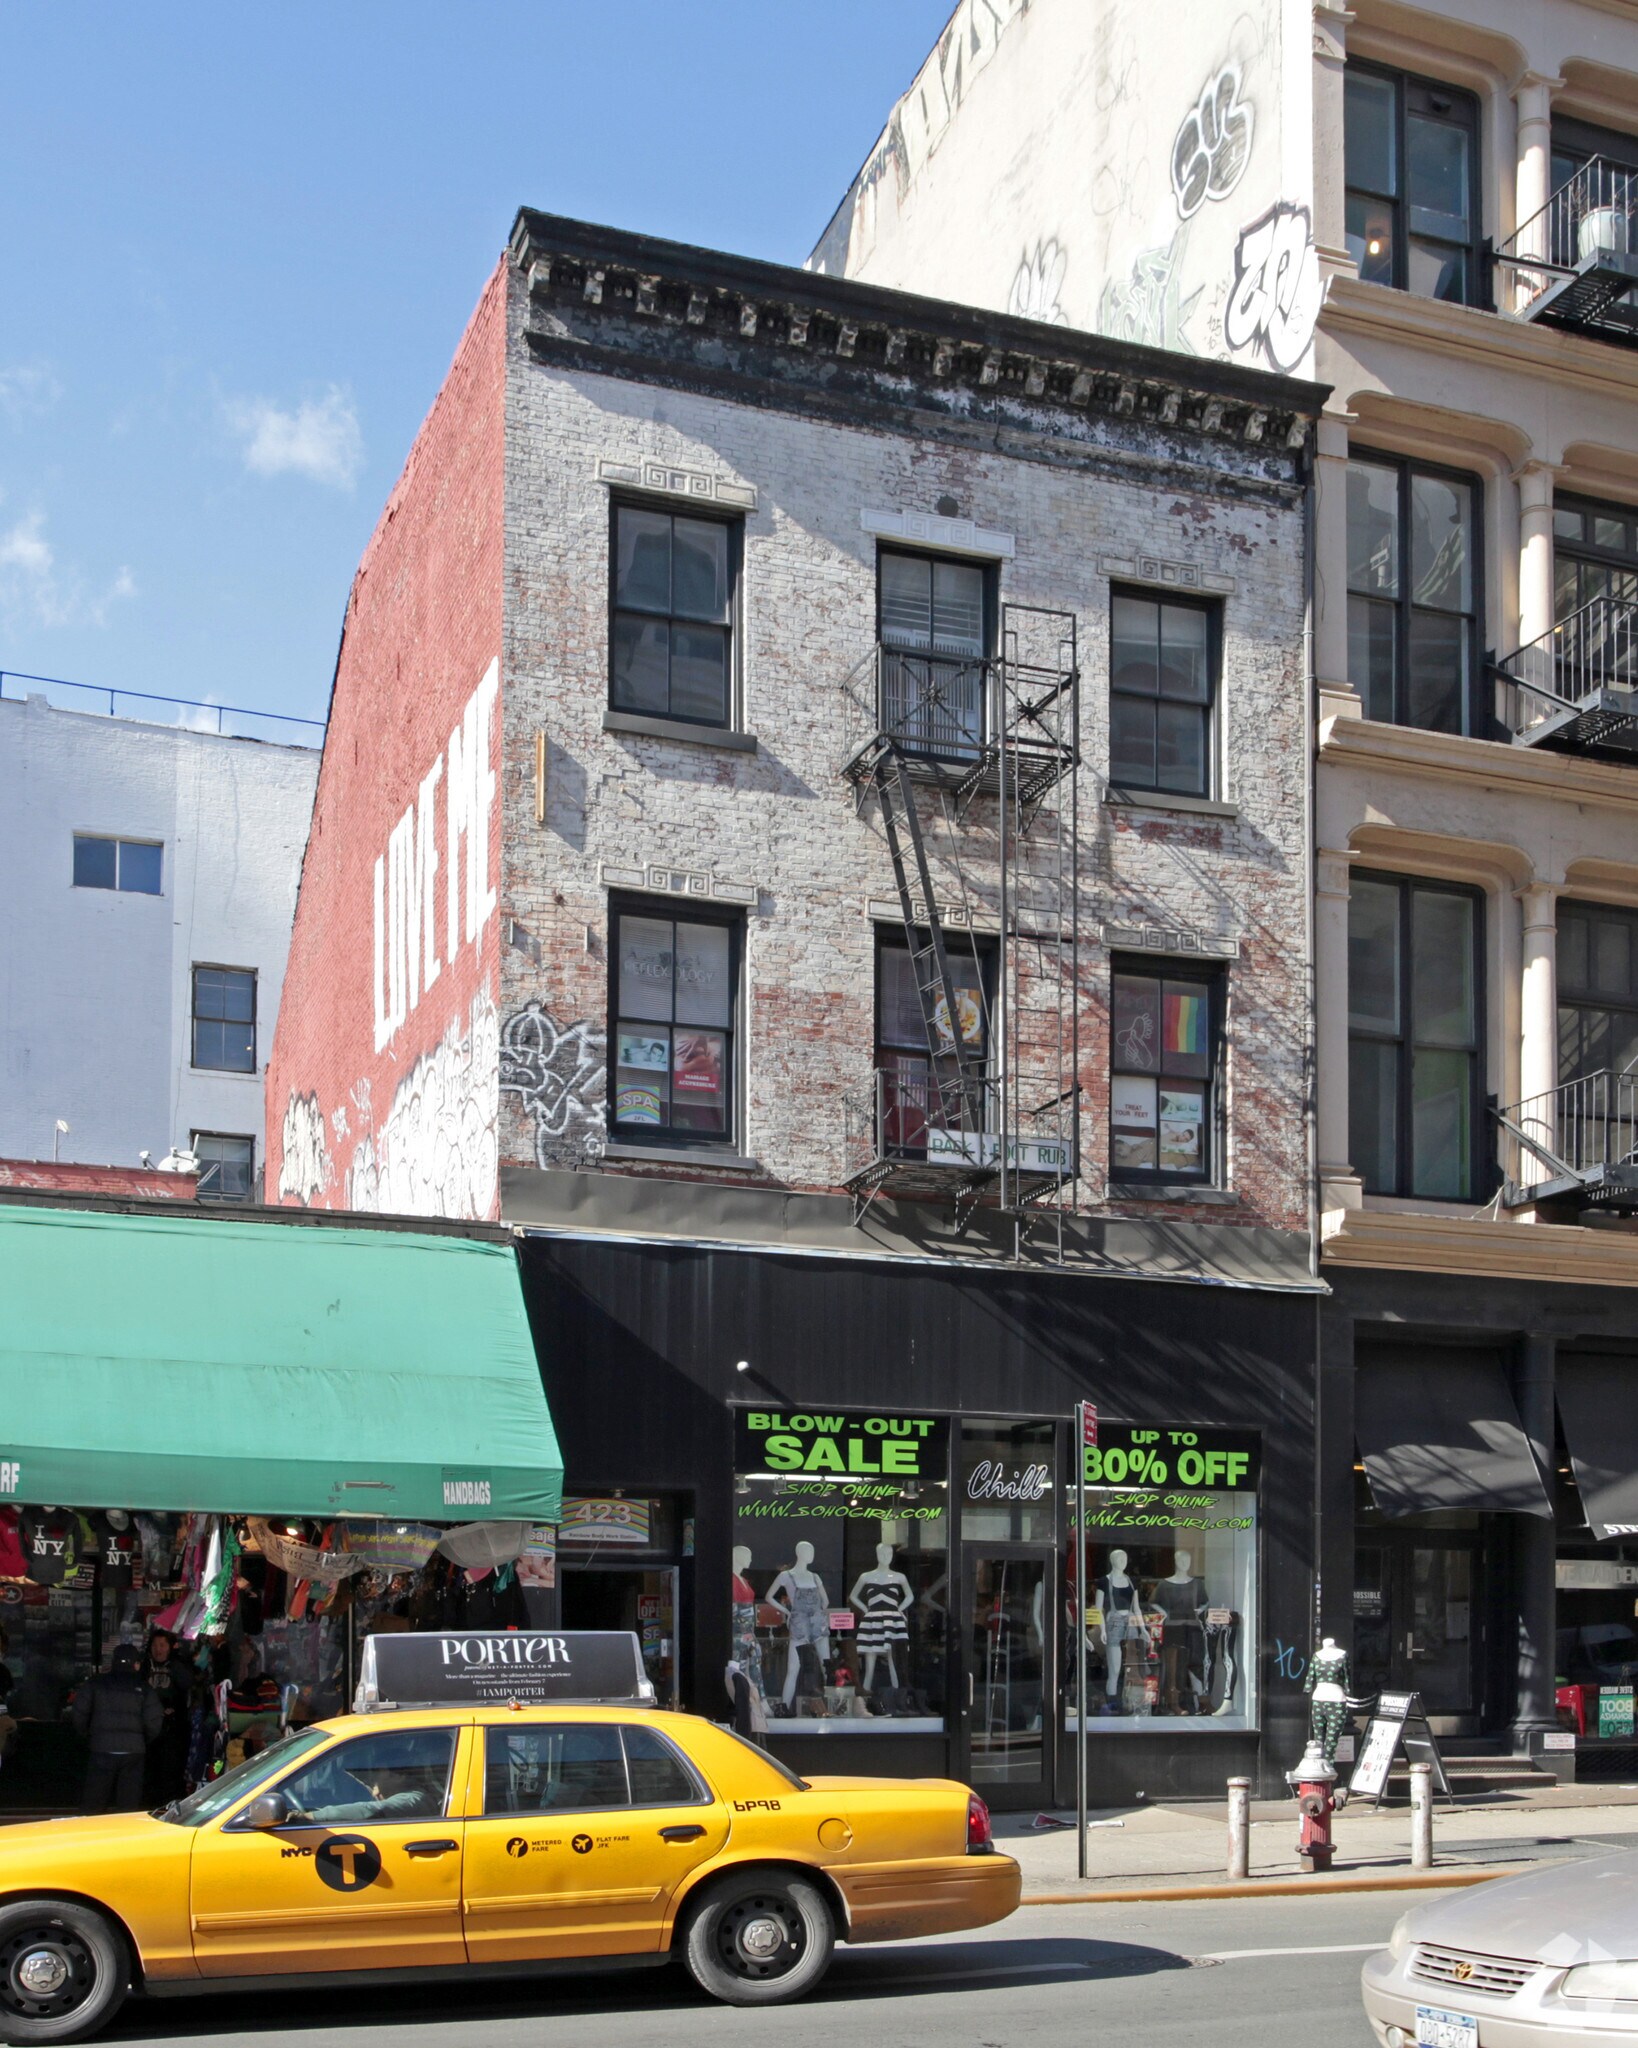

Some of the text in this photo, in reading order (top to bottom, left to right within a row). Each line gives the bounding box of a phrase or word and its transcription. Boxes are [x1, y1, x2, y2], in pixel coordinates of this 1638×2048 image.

[373, 752, 442, 1055] LOVE
[447, 655, 499, 964] ME
[622, 1093, 654, 1108] SPA
[1125, 1103, 1142, 1111] TREAT
[1038, 1148, 1066, 1165] RUB
[1131, 1430, 1198, 1445] UP TO
[764, 1435, 920, 1474] SALE
[1083, 1446, 1249, 1486] 80% OFF
[967, 1460, 1048, 1500] Chill
[443, 1481, 491, 1505] HANDBAGS
[779, 1483, 904, 1498] SHOP ONLINE
[1107, 1493, 1221, 1509] SHOP ONLINE
[575, 1503, 632, 1524] 423
[35, 1524, 45, 1539] I
[33, 1539, 65, 1556] NY
[108, 1536, 118, 1551] I
[106, 1551, 133, 1566] NY
[438, 1637, 573, 1664] PORTER
[476, 1687, 545, 1697] #IAMPORTER
[281, 1847, 312, 1858] NYC
